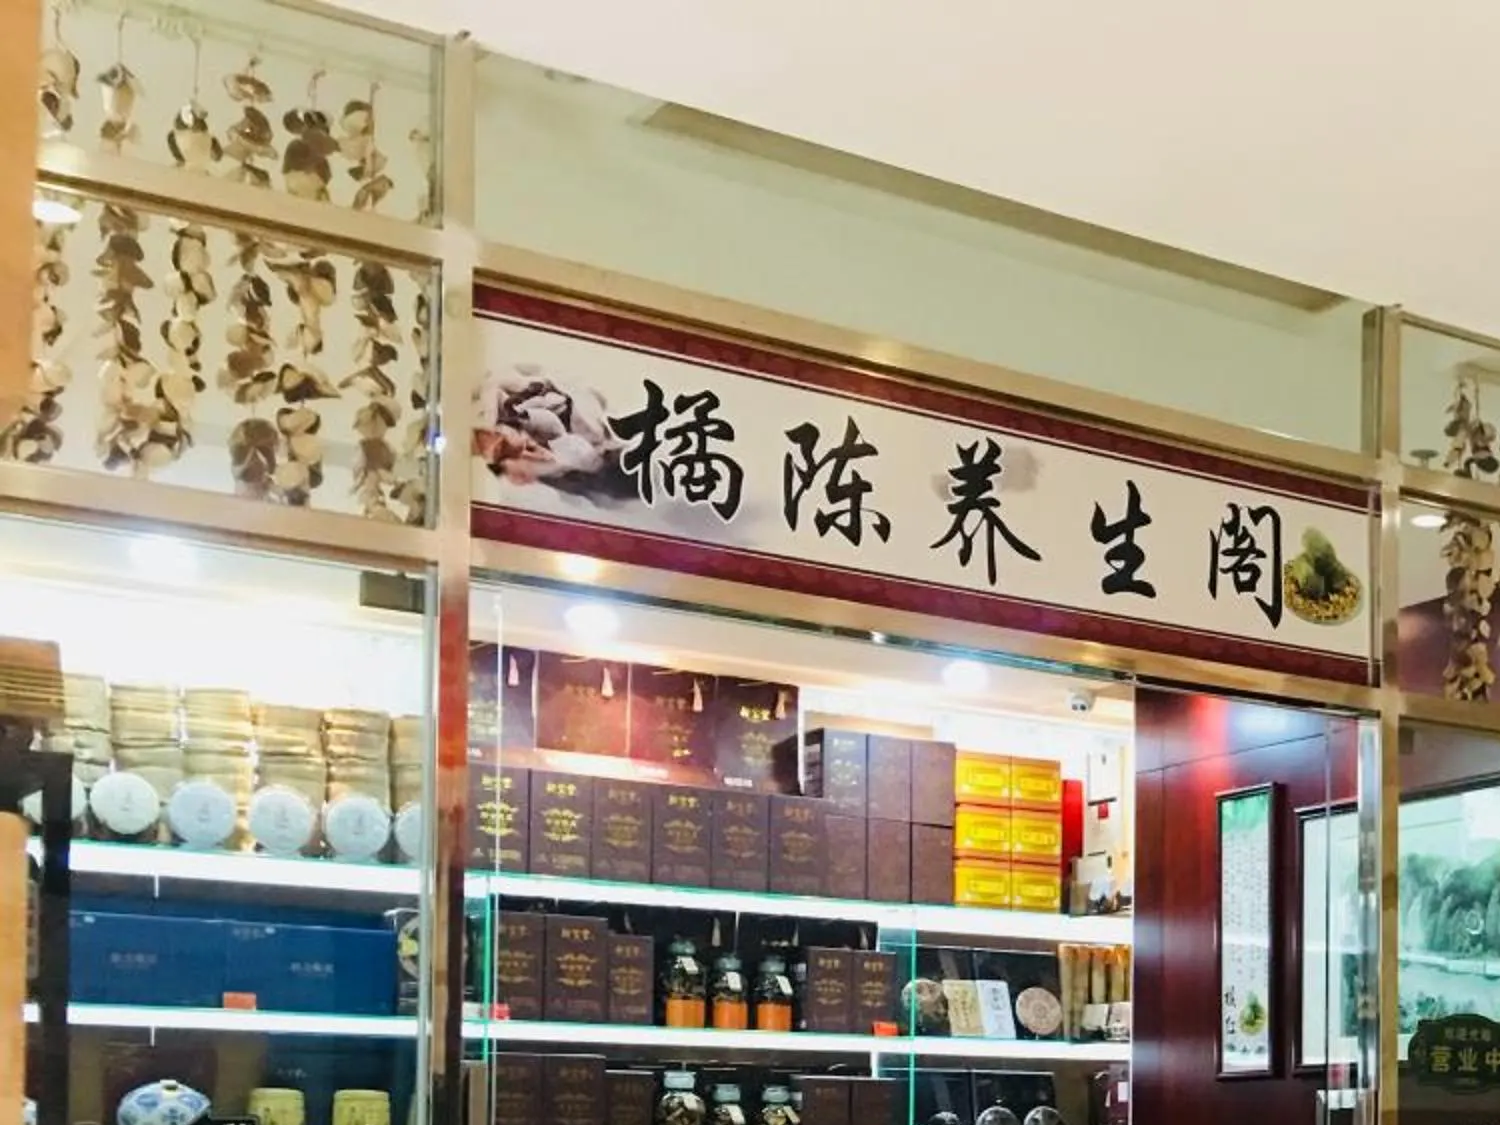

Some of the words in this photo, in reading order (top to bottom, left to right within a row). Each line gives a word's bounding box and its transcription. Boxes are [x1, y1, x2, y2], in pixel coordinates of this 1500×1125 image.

[608, 379, 1282, 629] 橘陈养生阁
